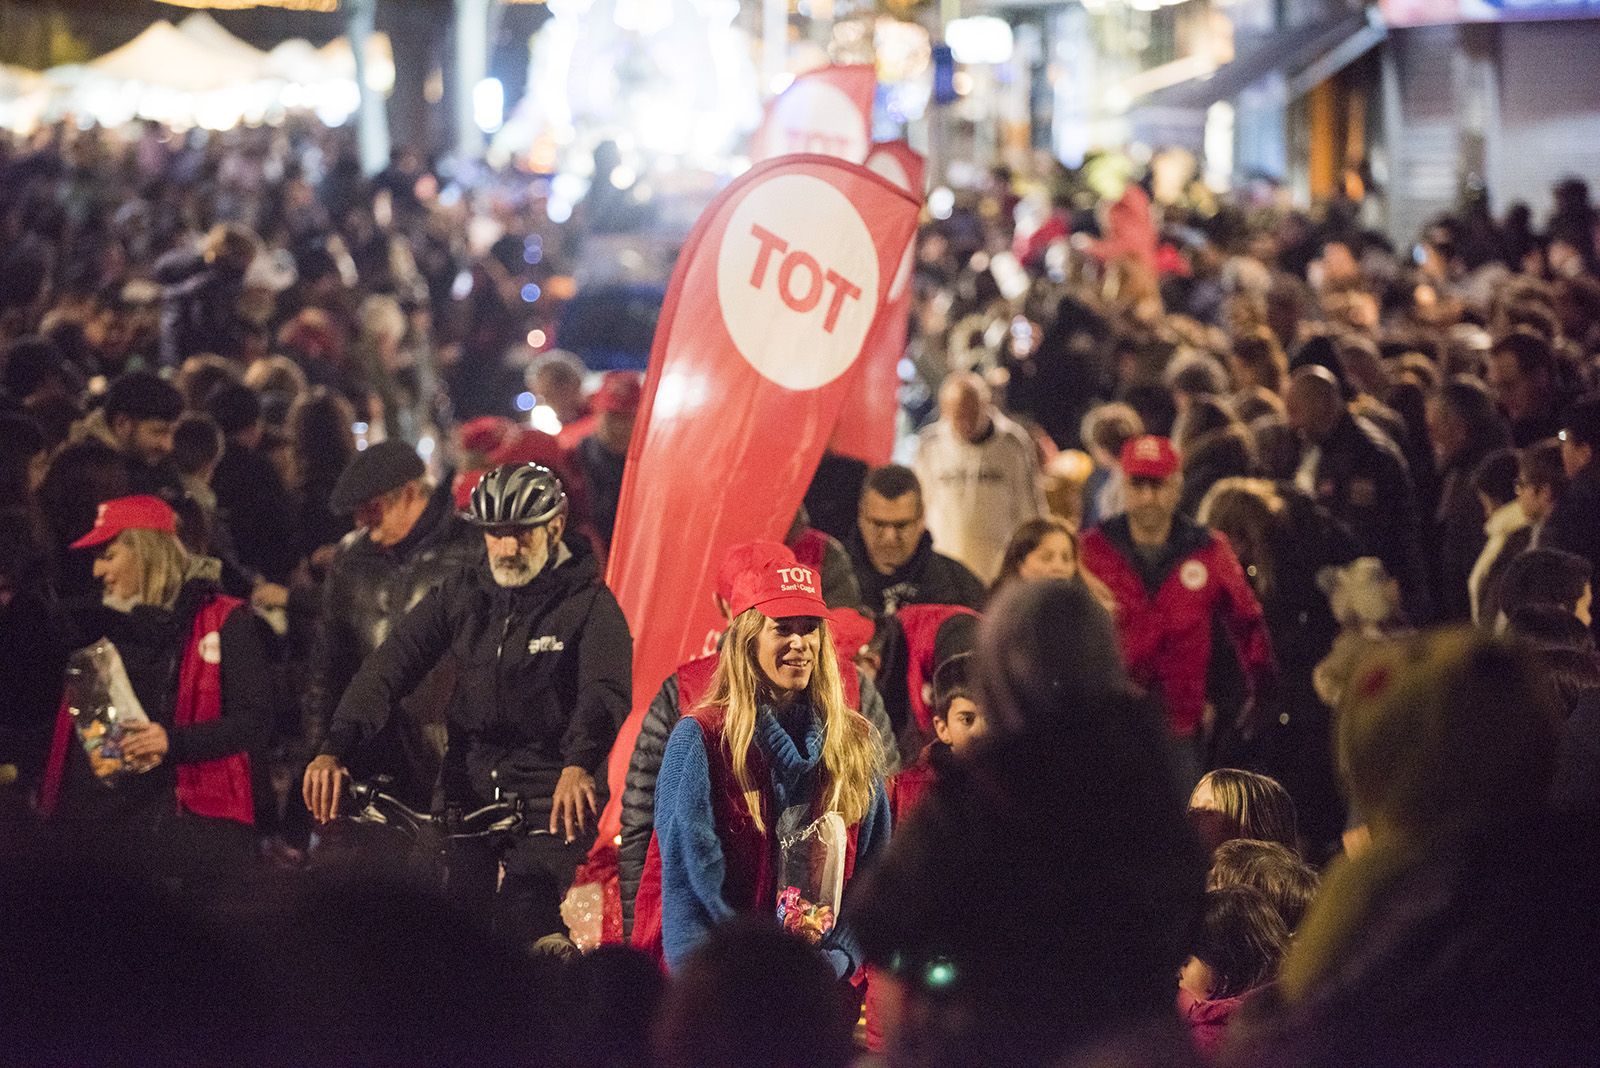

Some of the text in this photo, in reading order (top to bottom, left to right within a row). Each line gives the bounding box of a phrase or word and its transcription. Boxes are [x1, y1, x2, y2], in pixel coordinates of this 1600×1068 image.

[750, 223, 862, 334] TOT
[776, 567, 812, 585] TOT
[780, 584, 798, 592] Sant
